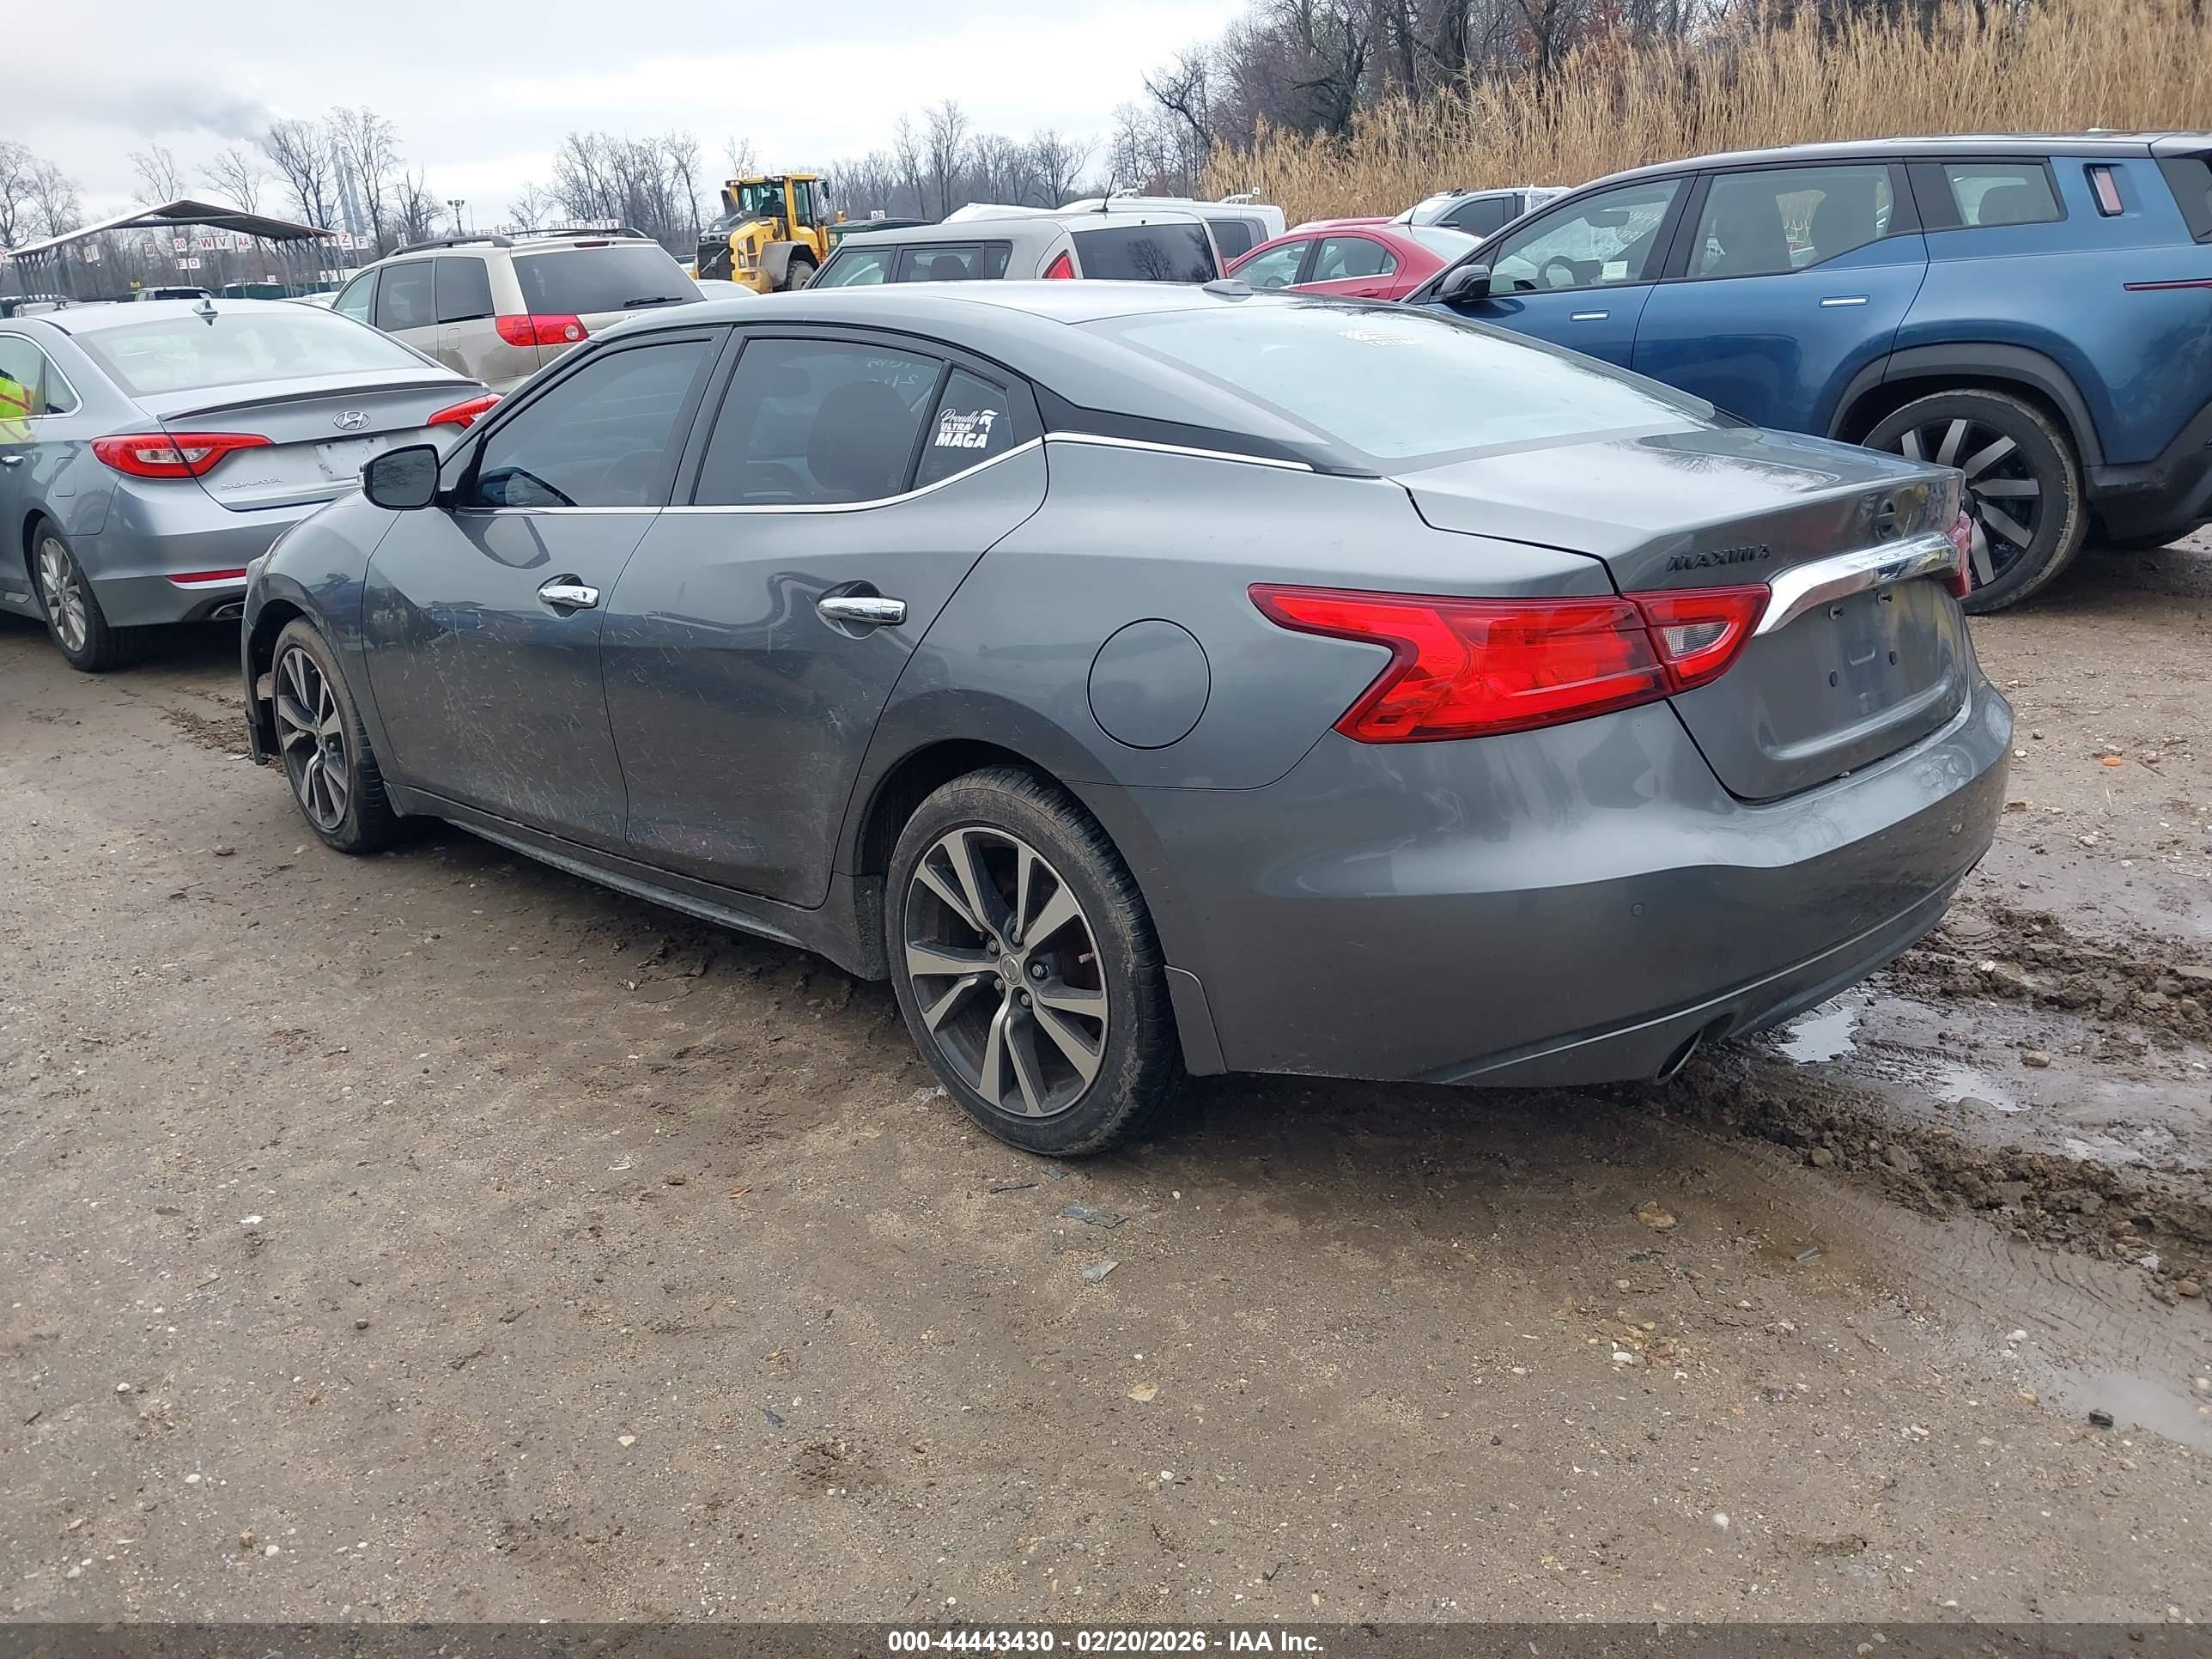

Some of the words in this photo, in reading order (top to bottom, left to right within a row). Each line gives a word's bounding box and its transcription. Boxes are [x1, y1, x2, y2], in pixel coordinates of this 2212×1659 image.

[200, 238, 212, 248] W
[218, 238, 227, 246] V
[238, 237, 250, 247] AA
[342, 234, 349, 244] Z
[358, 237, 364, 246] F
[146, 245, 154, 255] 20
[175, 240, 185, 250] 20
[940, 408, 980, 431] Proudly
[940, 422, 971, 431] ULTRA
[934, 432, 988, 448] MAGA
[220, 477, 283, 490] SONATA
[1666, 544, 1771, 572] MAXIMA
